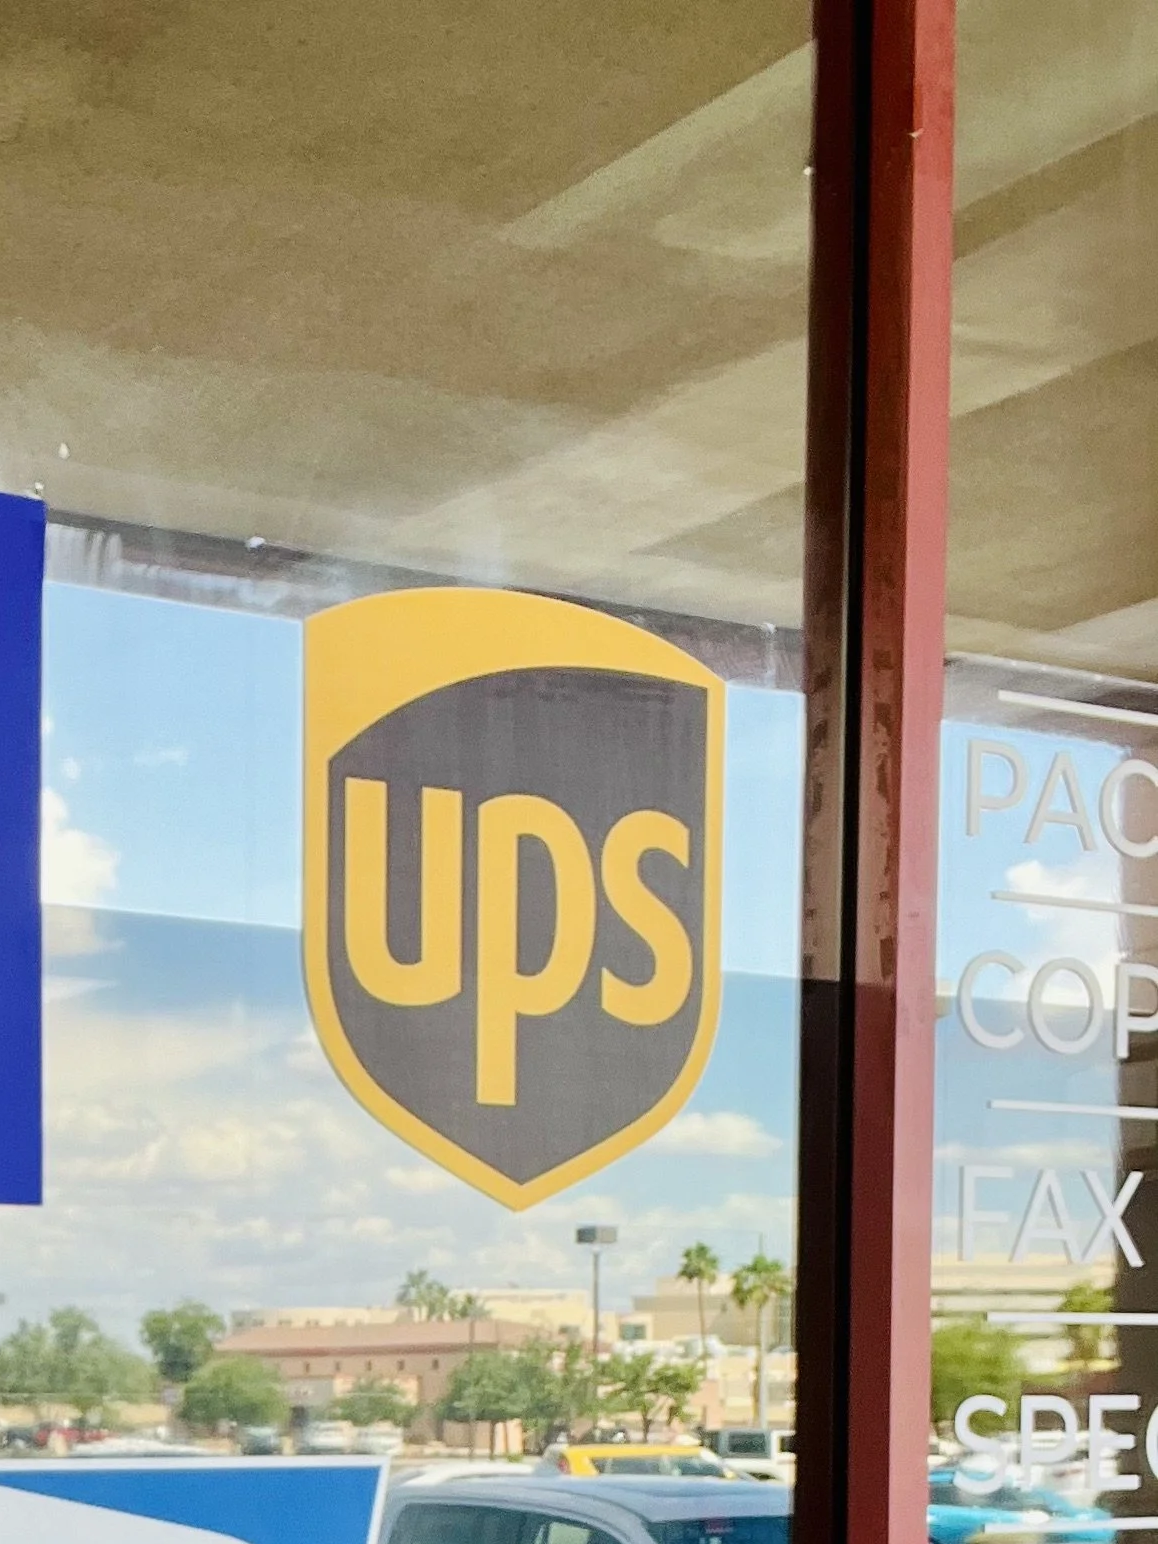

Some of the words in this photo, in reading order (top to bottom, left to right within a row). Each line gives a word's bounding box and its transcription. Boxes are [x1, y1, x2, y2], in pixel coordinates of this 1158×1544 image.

[345, 776, 693, 1106] ups
[957, 1165, 1145, 1268] FAX
[952, 1394, 1158, 1495] SPE
